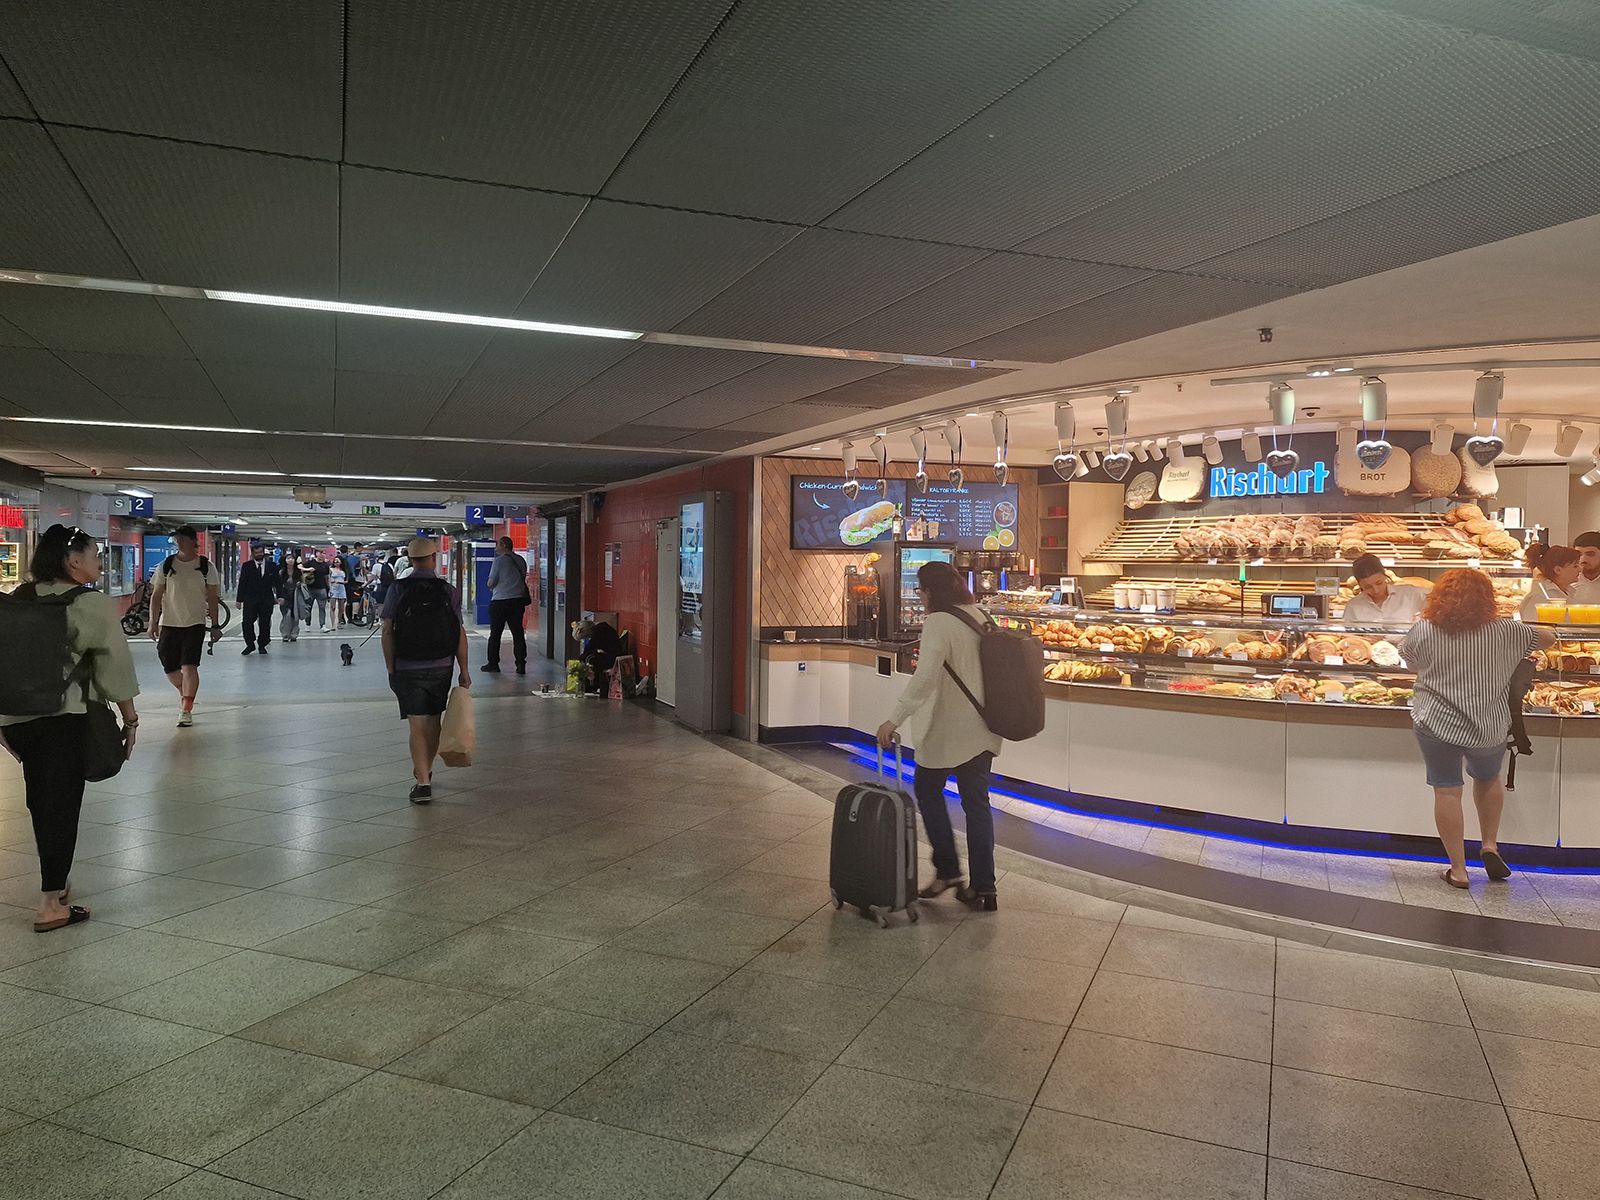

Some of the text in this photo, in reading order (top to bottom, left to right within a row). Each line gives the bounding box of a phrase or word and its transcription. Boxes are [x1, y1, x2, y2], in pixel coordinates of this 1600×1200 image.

[1210, 461, 1330, 497] Rischart
[1360, 473, 1386, 481] BROT
[799, 482, 844, 491] Chicken-Curr
[135, 498, 144, 510] 2
[473, 507, 481, 519] 2
